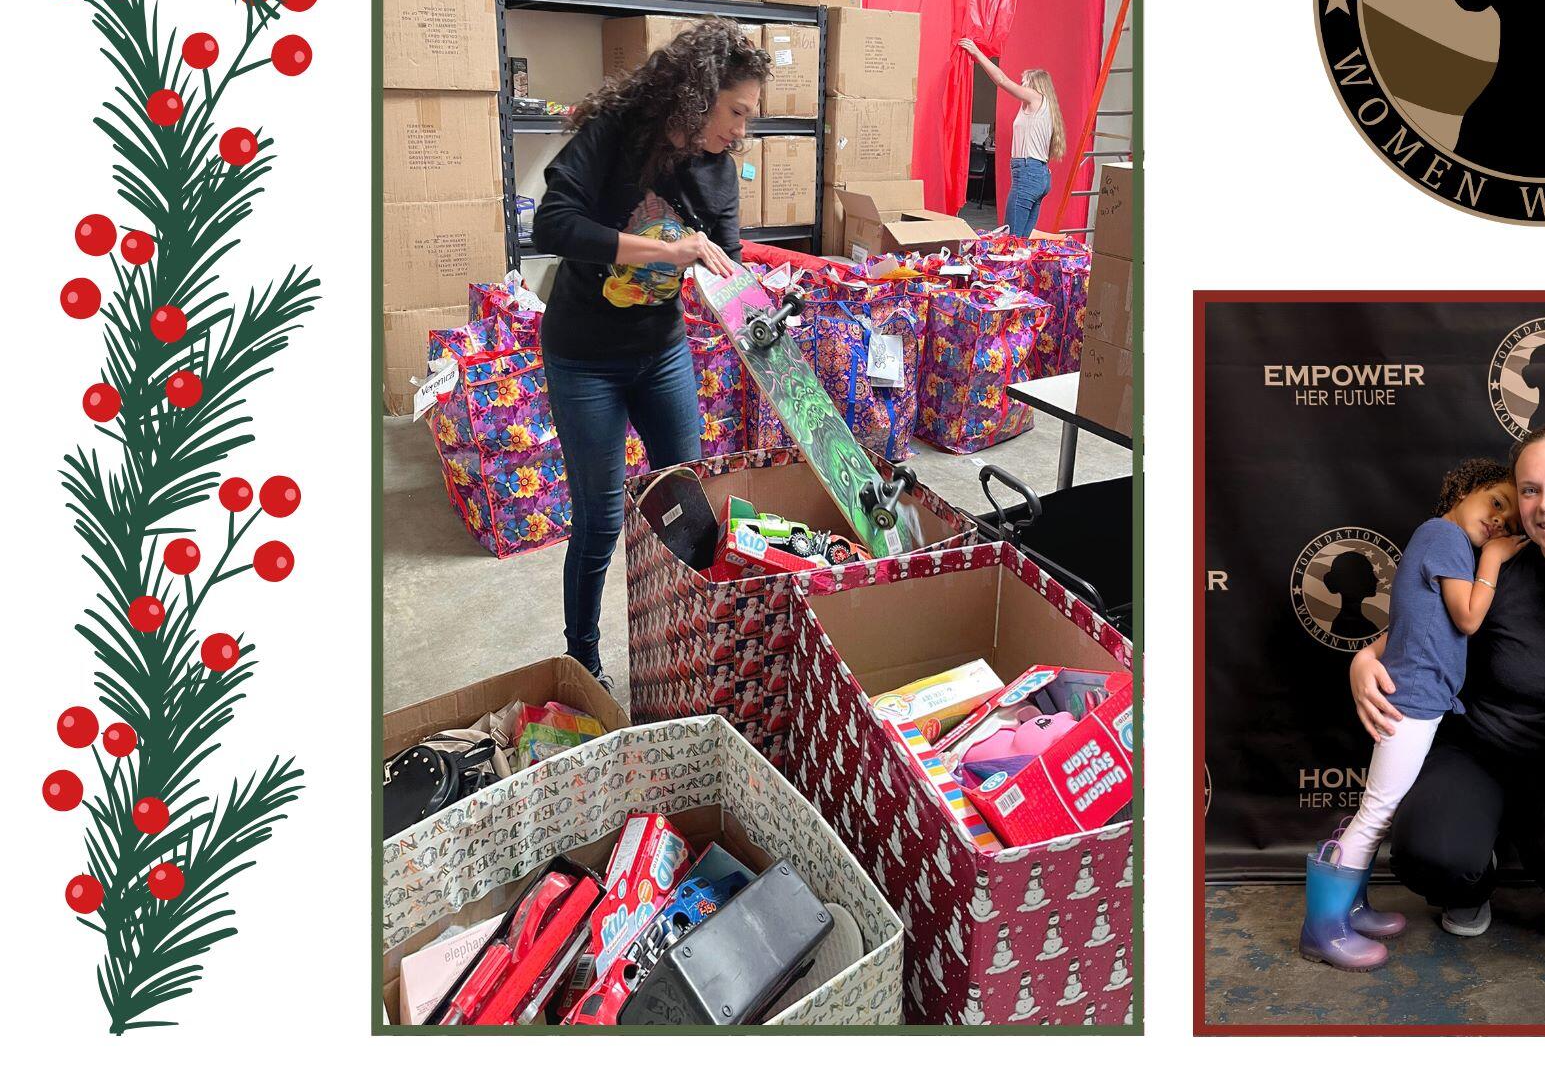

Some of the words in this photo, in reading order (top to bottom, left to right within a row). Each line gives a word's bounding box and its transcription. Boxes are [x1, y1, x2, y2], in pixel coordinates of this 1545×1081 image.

[421, 371, 455, 396] Veronica
[1264, 364, 1425, 386] EMPOWER
[1295, 390, 1328, 406] HER
[1334, 389, 1396, 405] FUTURE
[1495, 399, 1527, 437] WOME
[737, 530, 767, 553] KID
[1295, 529, 1381, 575] FOUNDATION
[1385, 544, 1401, 562] FO
[1296, 605, 1340, 647] WOMEN
[1062, 739, 1102, 775] Salon
[1065, 753, 1116, 795] Styling
[1074, 766, 1128, 812] Unicorn
[1299, 768, 1367, 789] HON
[1300, 792, 1332, 808] HER
[656, 831, 684, 890] KID
[603, 905, 628, 947] KID
